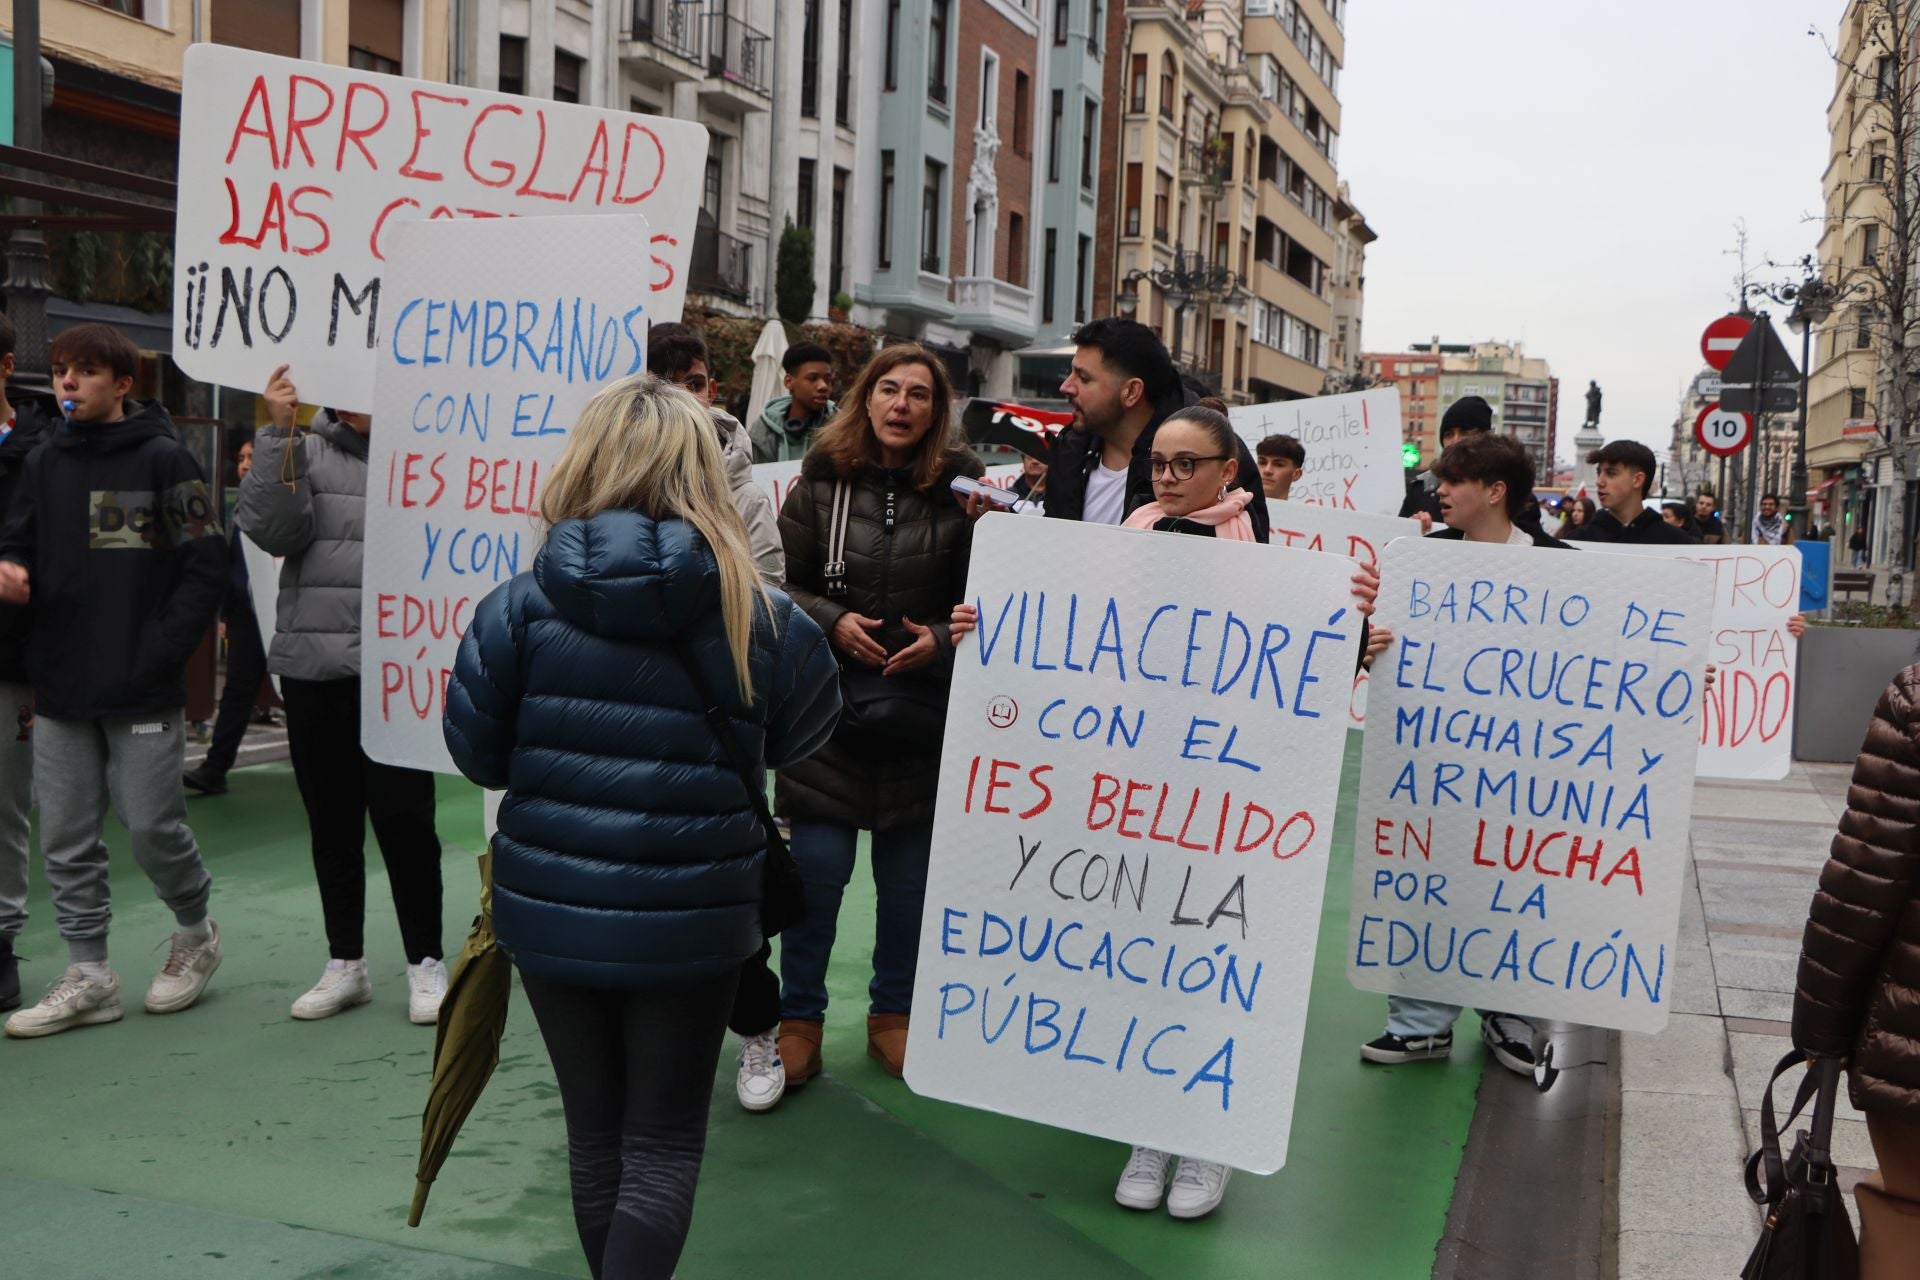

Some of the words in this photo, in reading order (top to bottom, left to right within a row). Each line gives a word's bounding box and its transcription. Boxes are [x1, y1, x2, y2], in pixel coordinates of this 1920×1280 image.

[225, 74, 665, 205] ARREGLAD
[219, 176, 334, 257] LAS
[392, 296, 644, 385] CEMBRANOS
[412, 392, 490, 443] CON
[511, 393, 567, 437] EL
[1712, 420, 1737, 438] 10
[387, 450, 448, 509] IES
[886, 492, 896, 527] NICE
[421, 521, 442, 581] Y
[448, 527, 520, 582] CON
[1410, 578, 1590, 627] BARRIO
[1621, 601, 1689, 647] DE
[975, 590, 1347, 718] VILLACEDRÉ
[1396, 635, 1446, 693] EL
[1038, 699, 1145, 748] CON
[1180, 714, 1261, 772] EL
[1395, 705, 1615, 771] MICHAISA
[964, 755, 1054, 820] IES
[1086, 771, 1316, 860] BELLIDO
[1009, 834, 1042, 891] Y
[1049, 848, 1150, 913] CON
[1170, 865, 1249, 940] LA
[1373, 869, 1448, 907] POR
[1489, 879, 1546, 920] LA
[1375, 816, 1432, 862] EN
[1472, 817, 1644, 897] LUCHA
[941, 906, 1263, 1013] EDUCACIÓN
[1356, 913, 1665, 1004] EDUCACIÓN
[937, 972, 1235, 1112] PÚBLICA
